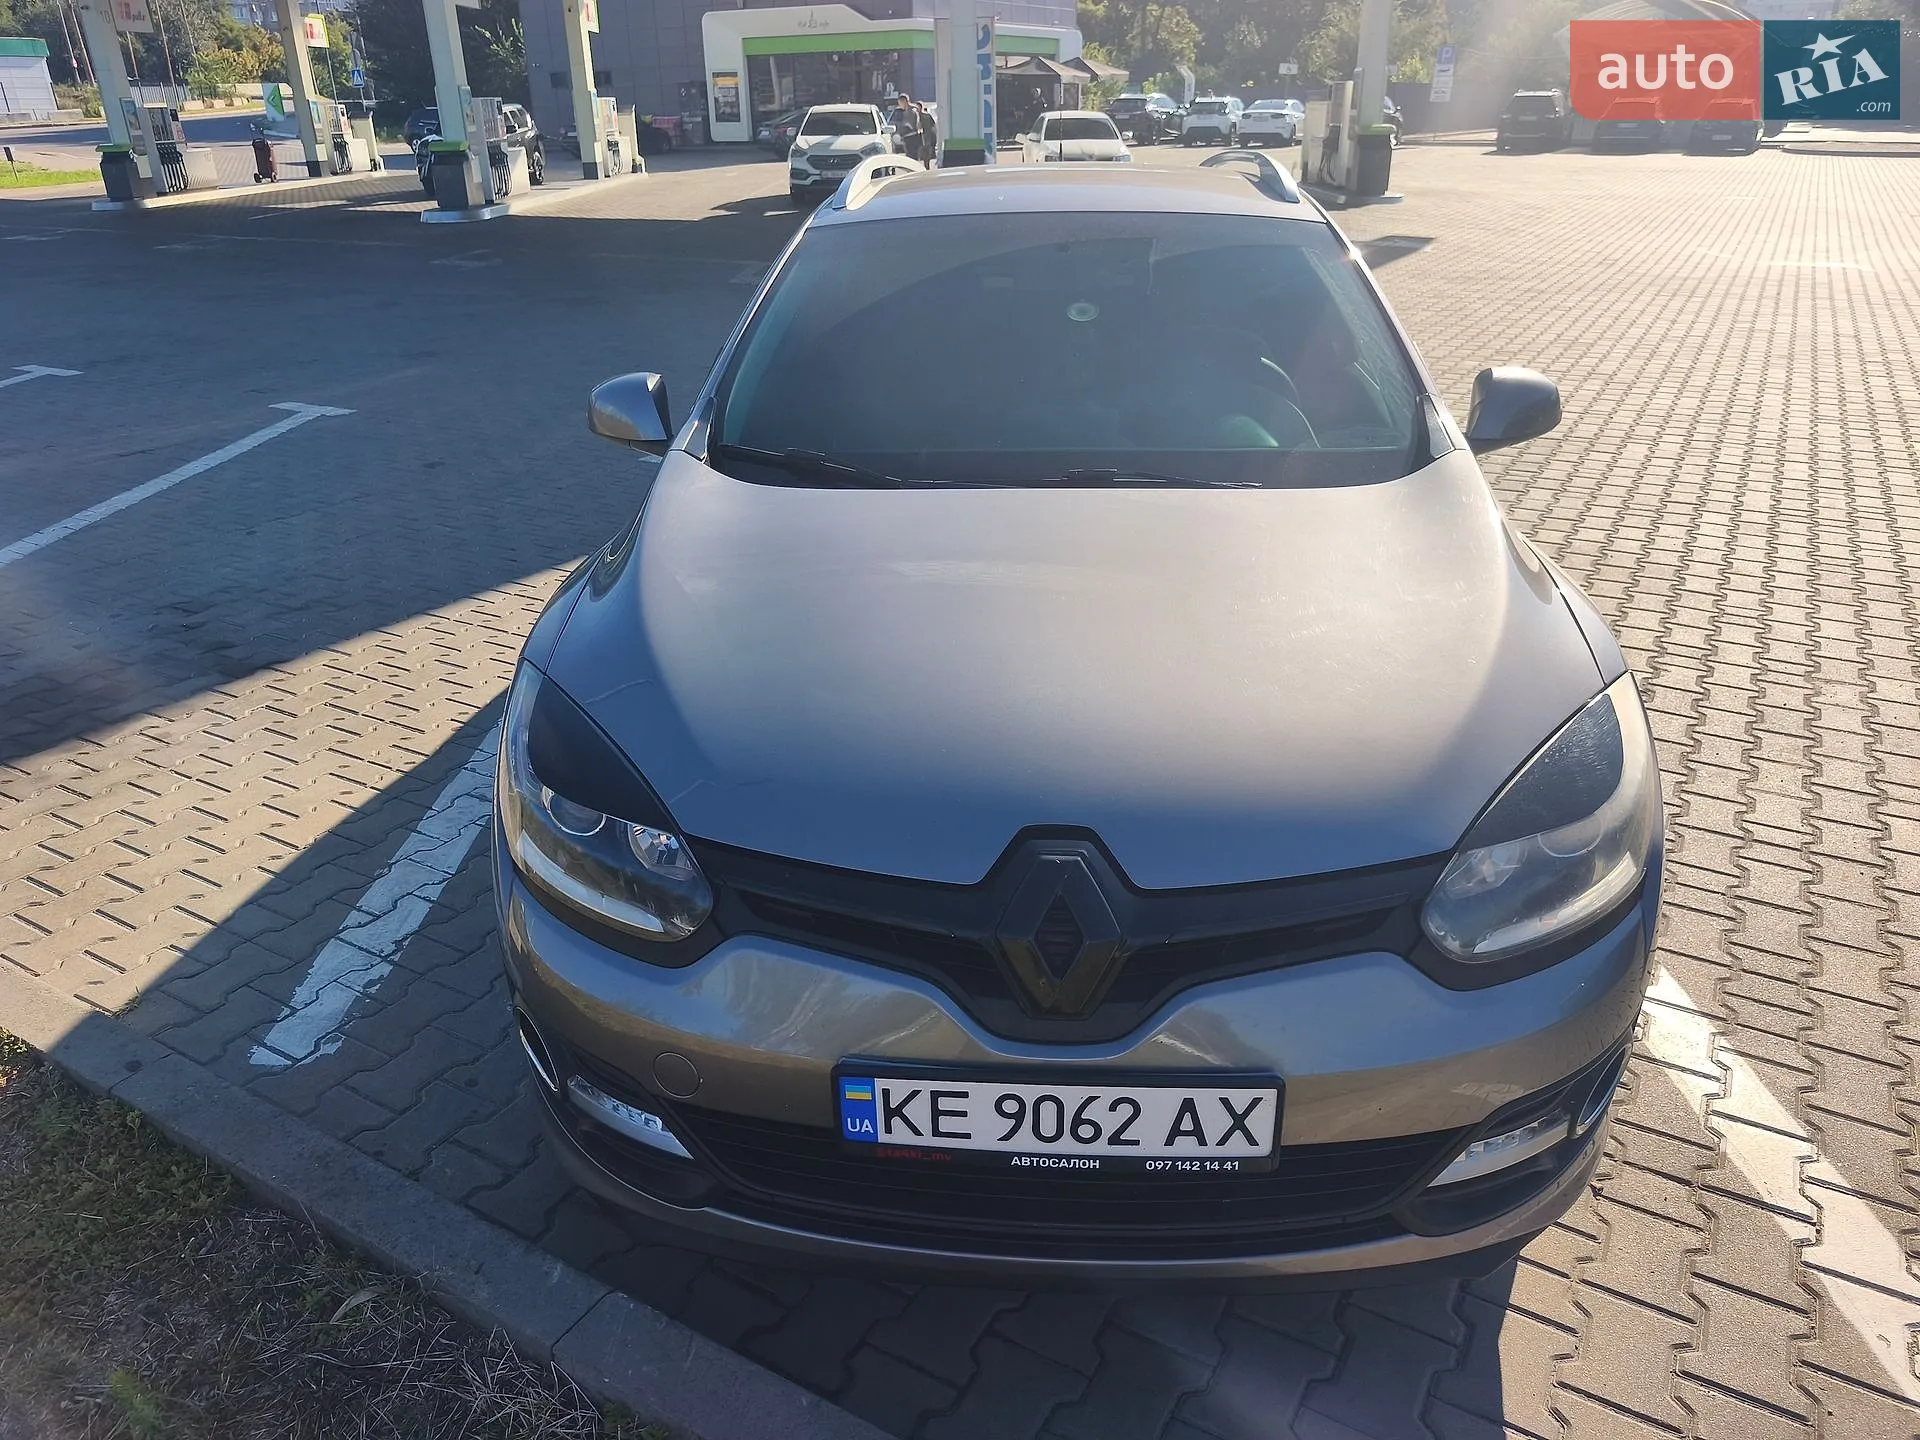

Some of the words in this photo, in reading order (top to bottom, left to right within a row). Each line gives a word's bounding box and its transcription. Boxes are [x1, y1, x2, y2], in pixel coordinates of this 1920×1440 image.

[881, 1087, 973, 1140] KE
[993, 1092, 1142, 1147] 9062
[1163, 1096, 1264, 1147] AX
[847, 1117, 874, 1134] UA
[1010, 1156, 1101, 1170] АВТОСАЛОН
[1145, 1160, 1173, 1171] 097
[1175, 1160, 1201, 1171] 142
[1203, 1160, 1220, 1171] 14
[1222, 1160, 1240, 1171] 41
